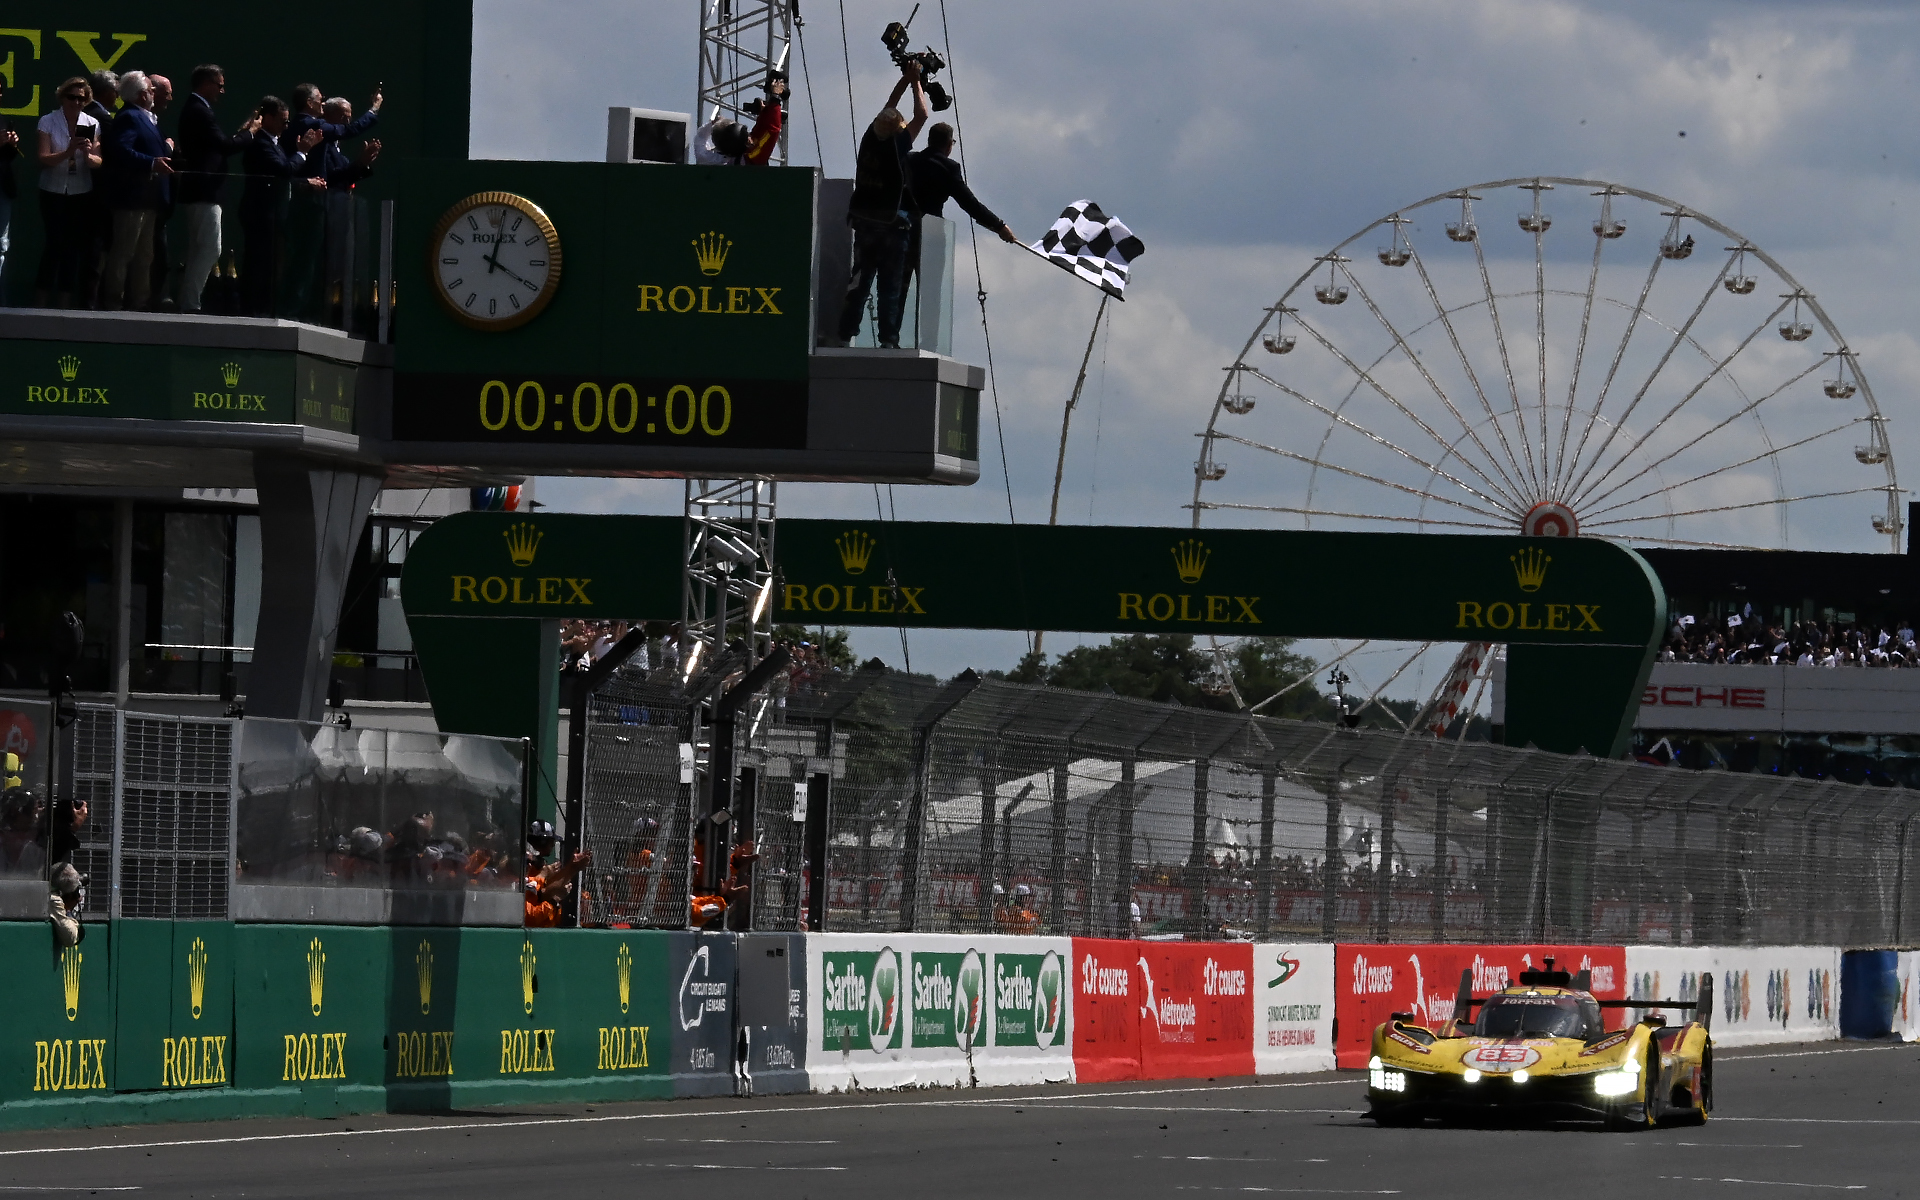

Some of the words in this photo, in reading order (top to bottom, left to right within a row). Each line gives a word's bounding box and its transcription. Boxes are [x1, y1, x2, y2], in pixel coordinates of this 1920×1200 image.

[472, 233, 517, 245] ROLEX
[637, 284, 783, 315] ROLEX
[26, 386, 109, 405] ROLEX
[193, 392, 266, 412] ROLEX
[302, 398, 322, 418] ROLEX
[479, 380, 733, 437] 00:00:00
[330, 403, 350, 423] ROLEX
[451, 575, 594, 606] ROLEX
[782, 583, 927, 615] ROLEX
[1117, 592, 1262, 624] ROLEX
[1456, 601, 1604, 632] ROLEX
[825, 961, 866, 1012] Sarthe
[914, 961, 953, 1011] Sarthe
[997, 962, 1033, 1011] Sarthe
[1098, 966, 1129, 996] course
[1218, 968, 1246, 996] course
[1368, 965, 1393, 994] course
[1484, 965, 1508, 991] course
[1160, 996, 1196, 1032] Métropole
[1428, 992, 1456, 1022] Métropol
[395, 1030, 454, 1078] ROLEX
[499, 1029, 556, 1074] ROLEX
[597, 1026, 649, 1071] ROLEX
[1390, 1033, 1415, 1047] ORLEN
[1479, 1049, 1525, 1061] 83
[1598, 1036, 1626, 1050] ORLEN
[33, 1038, 107, 1092] ROLEX
[162, 1035, 227, 1087] ROLEX
[282, 1031, 347, 1081] ROLEX
[706, 1047, 714, 1068] km
